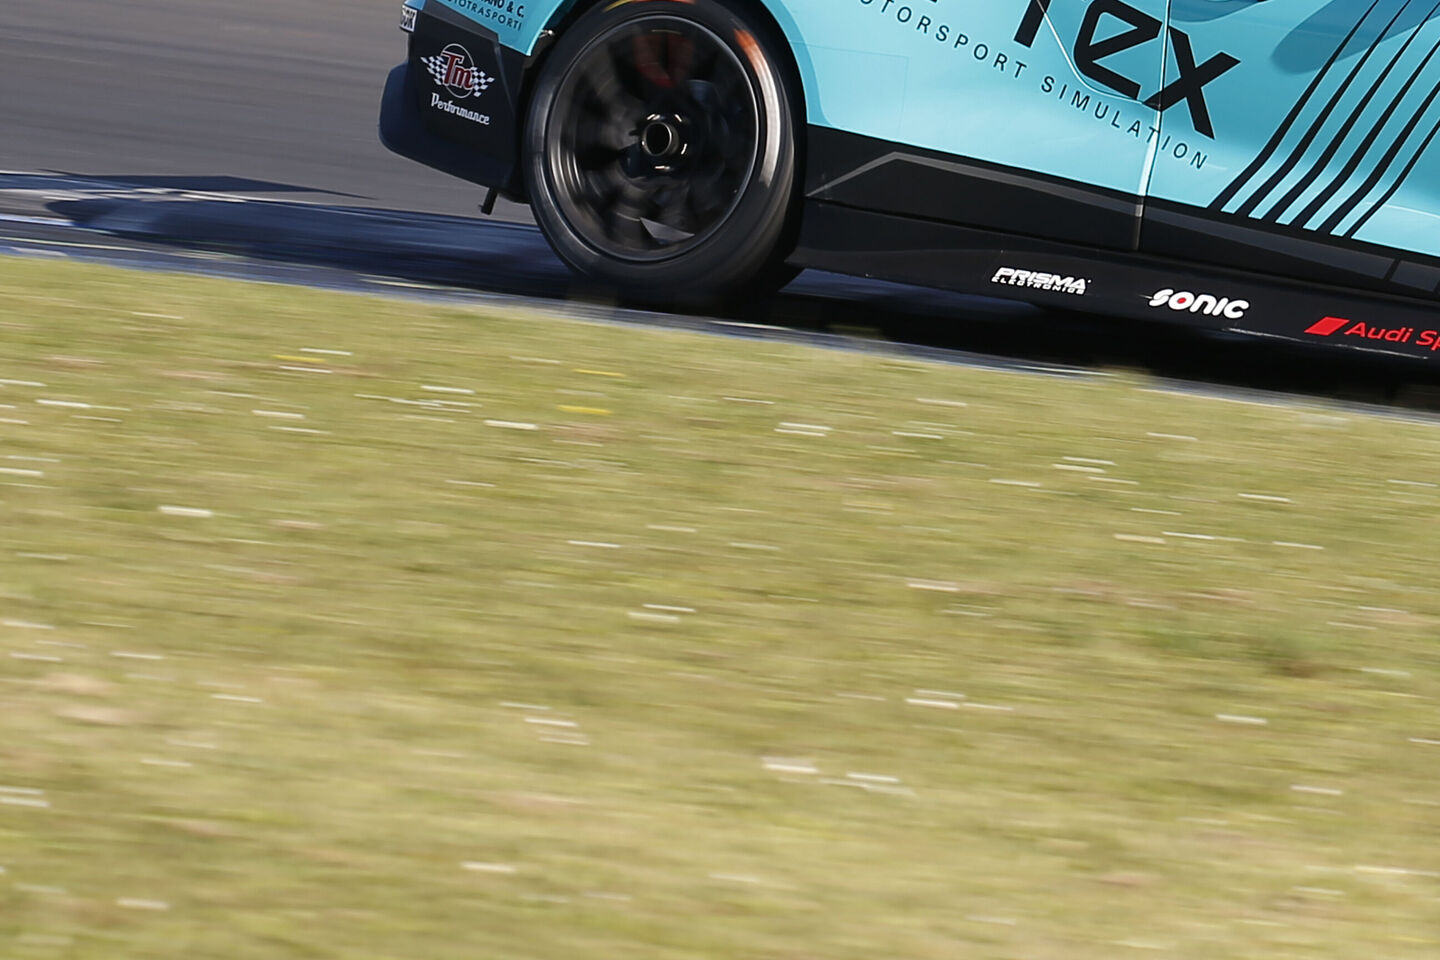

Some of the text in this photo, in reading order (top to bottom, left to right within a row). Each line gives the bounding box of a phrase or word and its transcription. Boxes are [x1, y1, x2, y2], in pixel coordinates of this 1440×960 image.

[506, 1, 515, 14] &
[430, 91, 491, 126] Performance
[1040, 74, 1208, 171] SIMULATION
[991, 276, 1085, 295] ELECTRONICS
[994, 266, 1086, 290] PRISMA
[1344, 321, 1414, 344] Audi
